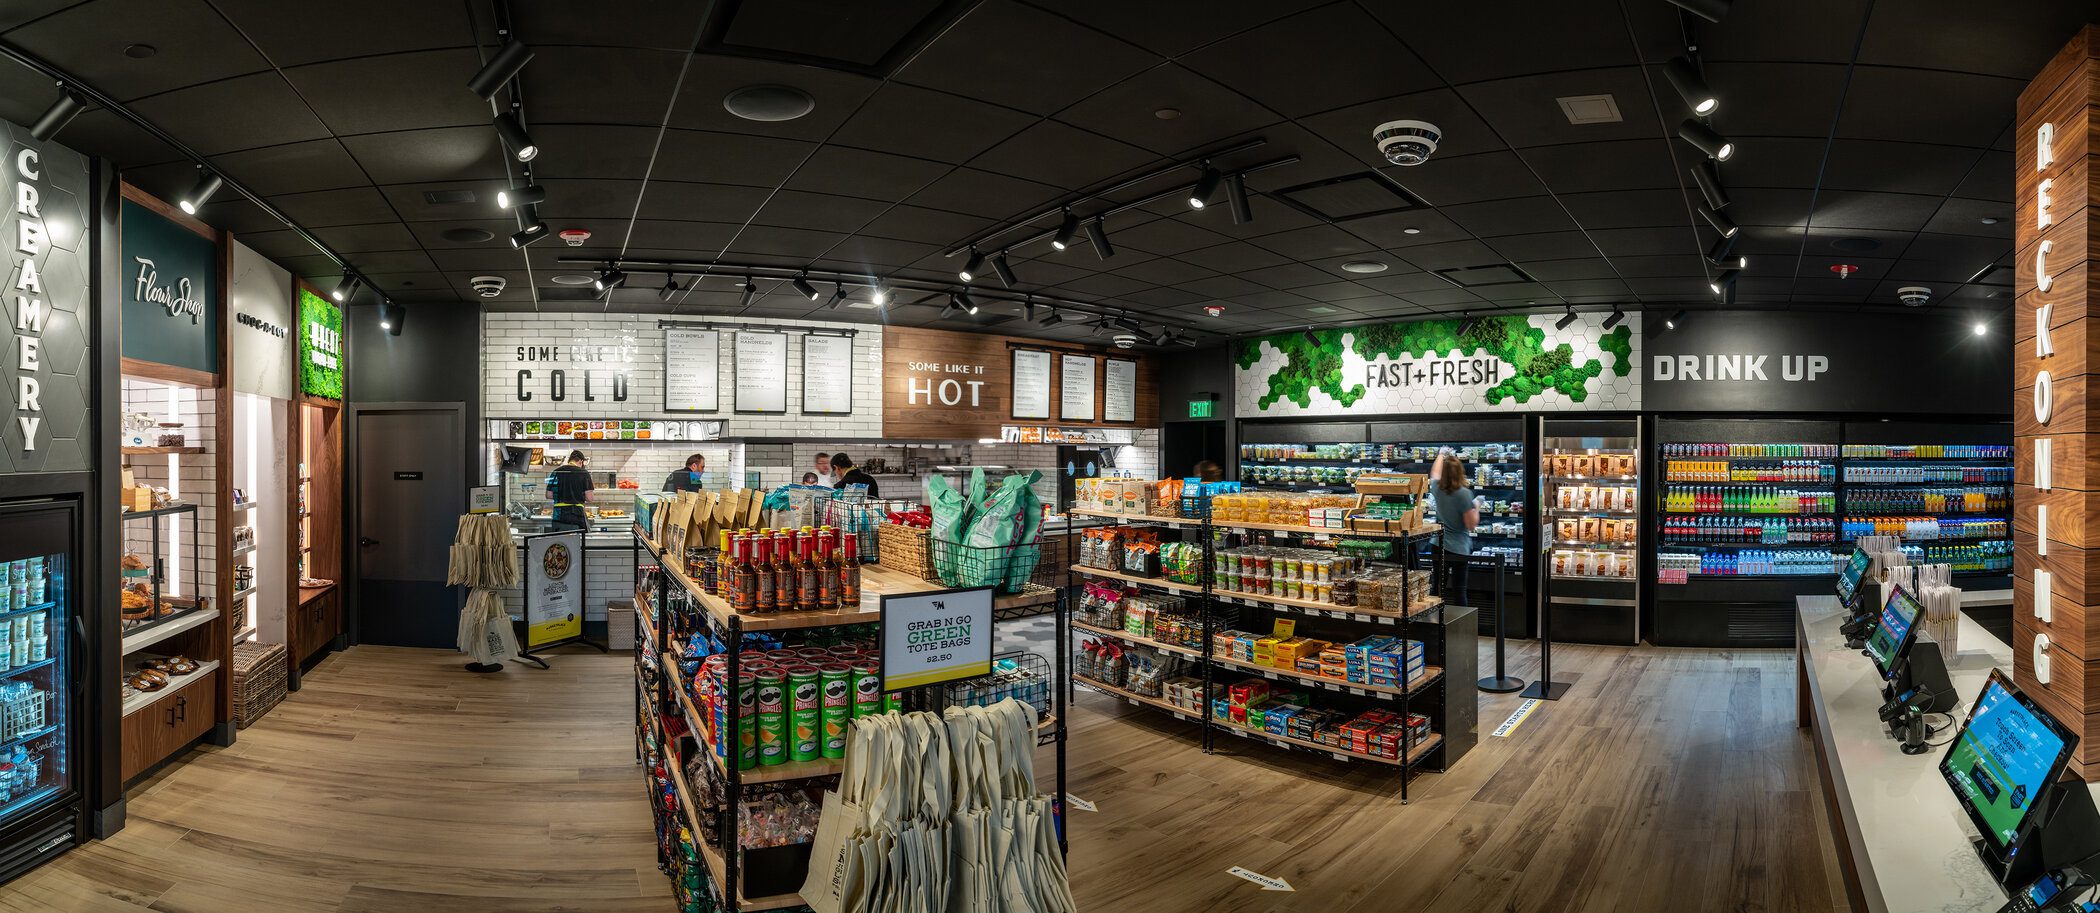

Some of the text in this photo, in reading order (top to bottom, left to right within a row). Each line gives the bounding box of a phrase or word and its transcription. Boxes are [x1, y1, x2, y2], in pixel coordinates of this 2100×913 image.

[136, 255, 204, 325] Flour Shop
[17, 148, 42, 451] CREAMERY
[517, 346, 559, 361] SOME
[909, 361, 984, 375] SOME LIKE IT
[1366, 358, 1499, 388] FAST+FRESH
[1653, 355, 1829, 381] DRINK UP
[517, 369, 628, 401] COLD
[908, 378, 985, 407] HOT
[1191, 402, 1209, 417] EXIT
[2033, 121, 2055, 686] RECKONING
[907, 615, 972, 631] GRAB N GO
[907, 624, 971, 644] GREEN
[907, 637, 971, 653] TOTE BAGS
[926, 653, 952, 663] $2.50
[795, 699, 818, 711] PRINGLES
[825, 696, 848, 707] PRINGLES
[857, 691, 880, 703] PRINGLES
[759, 703, 782, 713] PRINGLES
[1995, 717, 2027, 752] Touch Screen
[2003, 737, 2016, 754] Scan
[1989, 744, 2010, 770] Checkout
